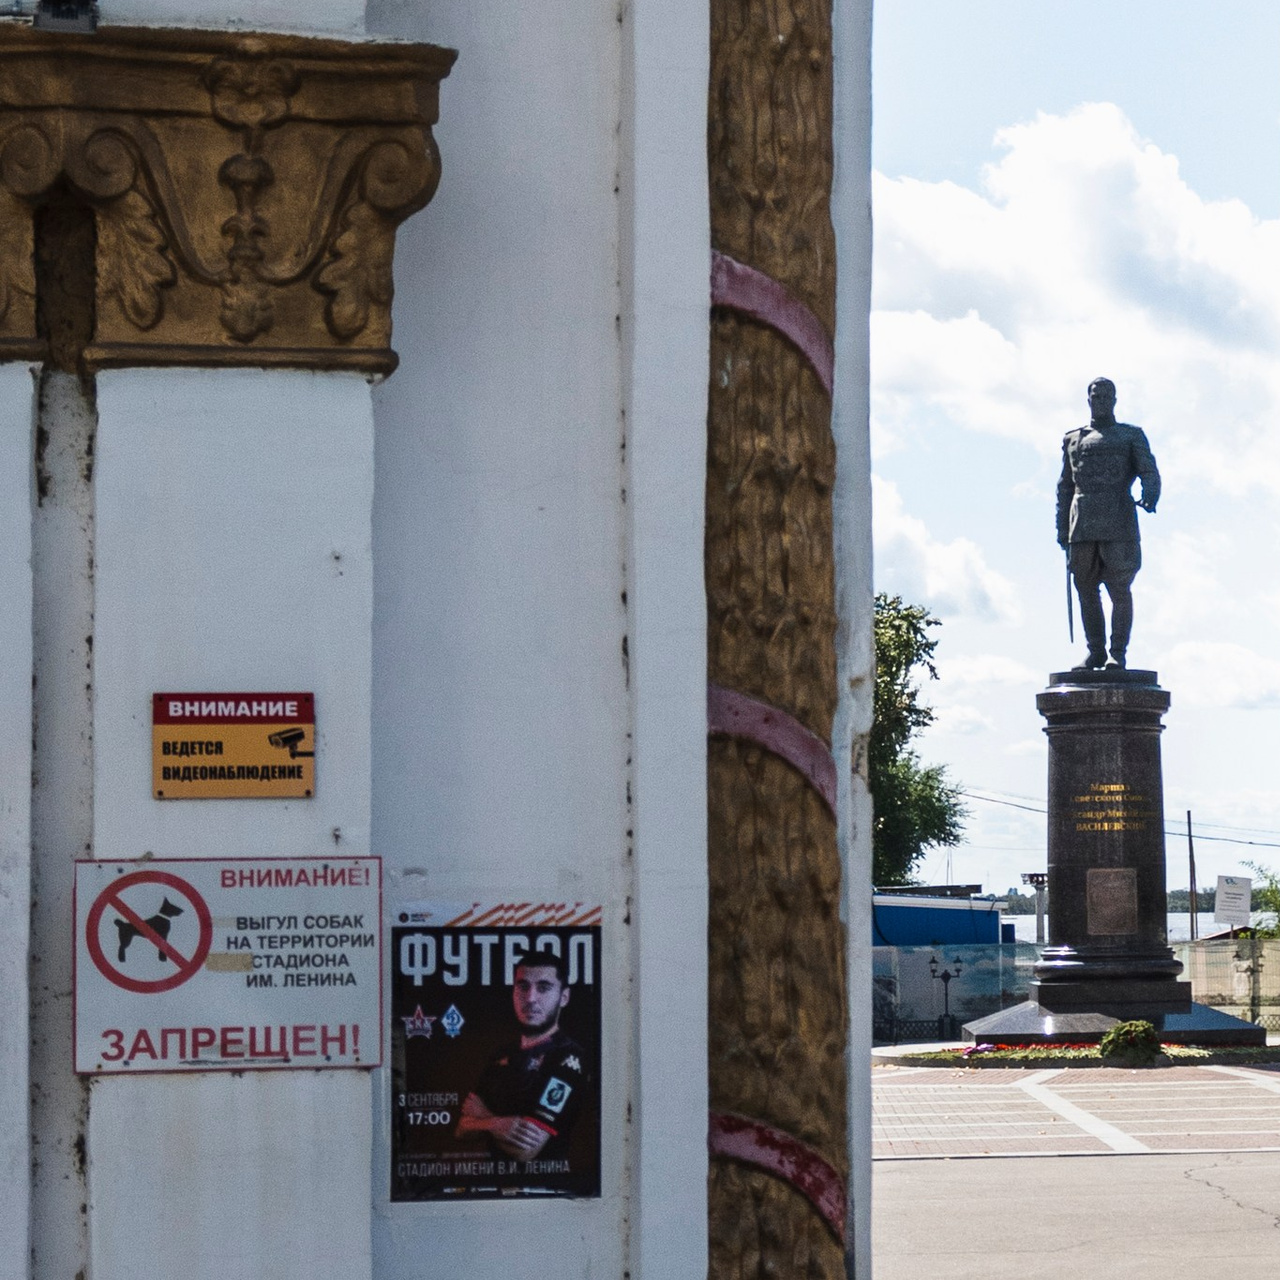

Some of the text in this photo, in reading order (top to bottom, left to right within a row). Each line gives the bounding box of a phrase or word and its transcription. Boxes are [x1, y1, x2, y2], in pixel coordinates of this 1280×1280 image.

[168, 701, 298, 717] ВНИМАНИЕ
[162, 741, 223, 757] ВЕДЕТСЯ
[162, 765, 303, 782] ВИДЕОНАБЛЮДЕНИЕ
[220, 867, 370, 888] ВНИМАНИЕ!
[236, 915, 364, 931] ВЫГУЛ СОБАК
[226, 934, 375, 950] НА ТЕРРИТОРИИ
[252, 953, 350, 970] СТАДИОНА
[246, 973, 357, 988] ИМ. ЛЕНИНА
[100, 1024, 360, 1062] ЗАПРЕЩЕН!
[407, 1093, 459, 1107] СЕНТЯБРЯ
[408, 1111, 451, 1125] 17:00
[398, 1161, 450, 1177] СТАДИОН
[454, 1161, 494, 1176] ИМЕНИ
[525, 1160, 571, 1174] ЛЕНИНА
